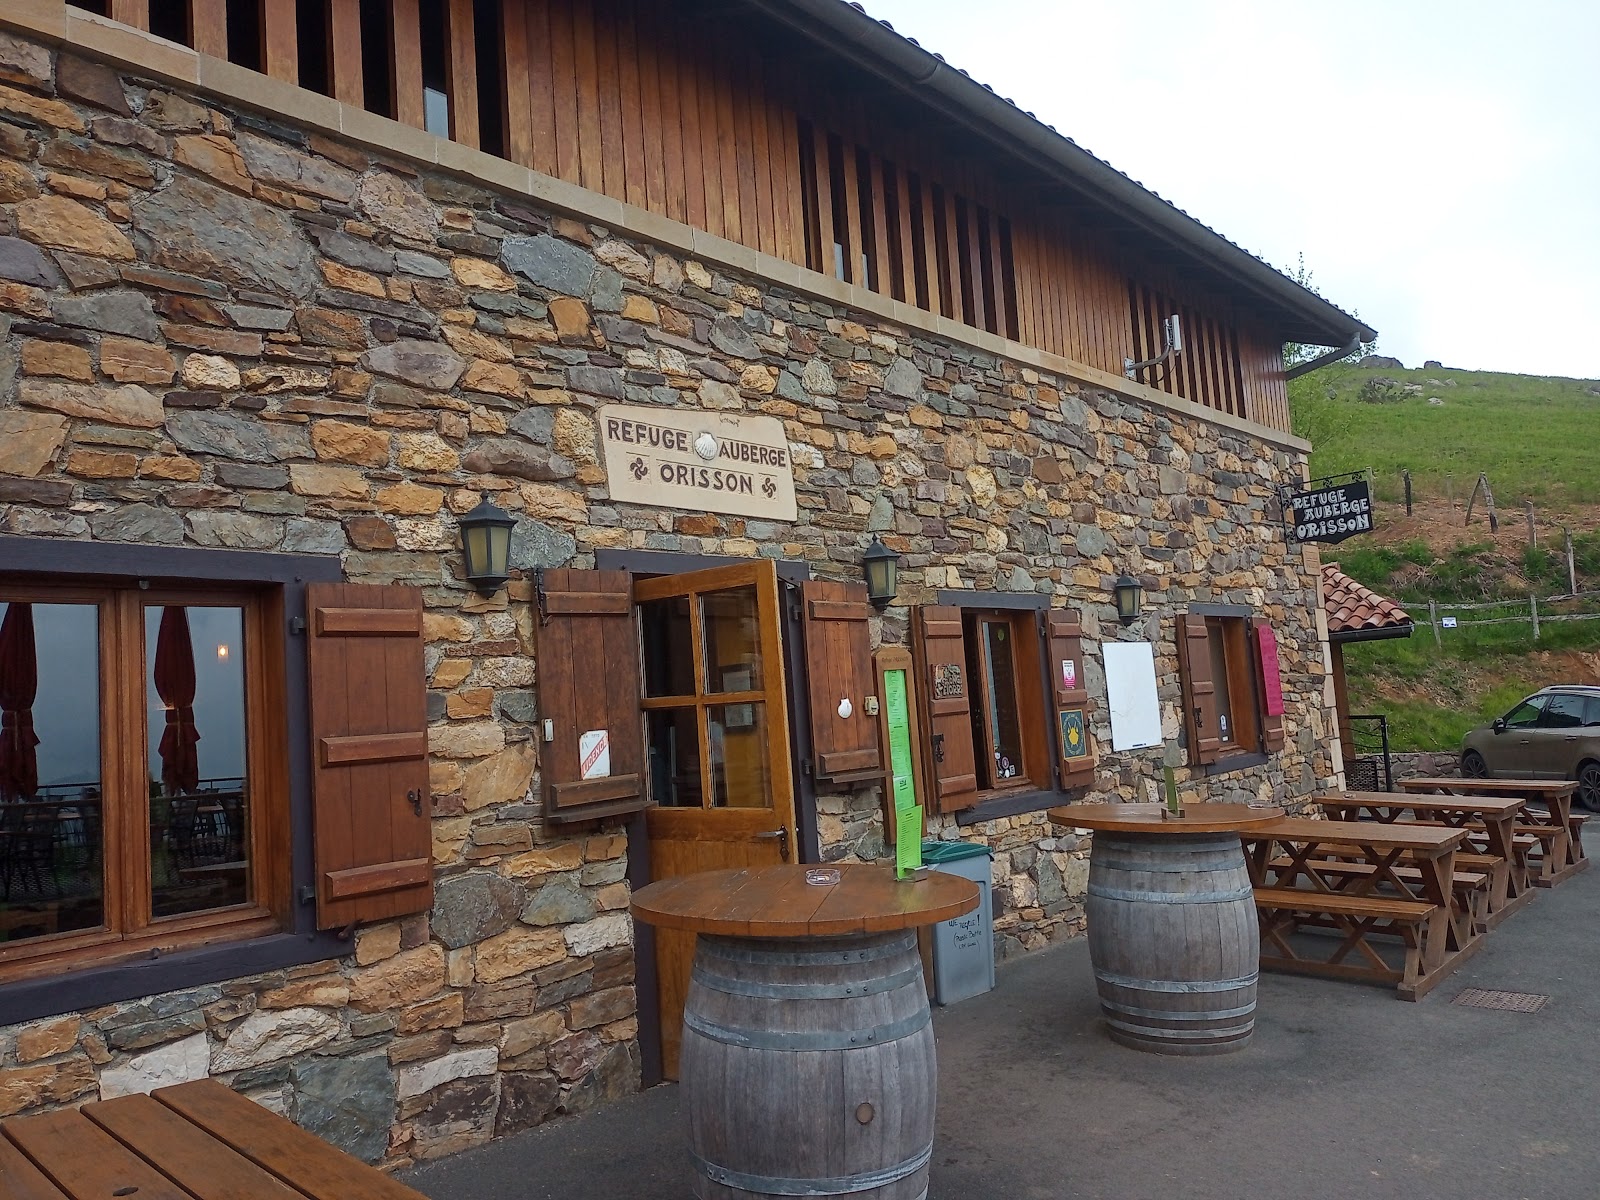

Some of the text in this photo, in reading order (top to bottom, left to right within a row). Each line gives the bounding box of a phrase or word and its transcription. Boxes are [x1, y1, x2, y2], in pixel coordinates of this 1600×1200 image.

[607, 419, 787, 468] REFUGE AUBERGE
[660, 463, 753, 495] ORISSON
[1292, 489, 1346, 509] REFUGE
[1303, 498, 1369, 521] AUBERGE
